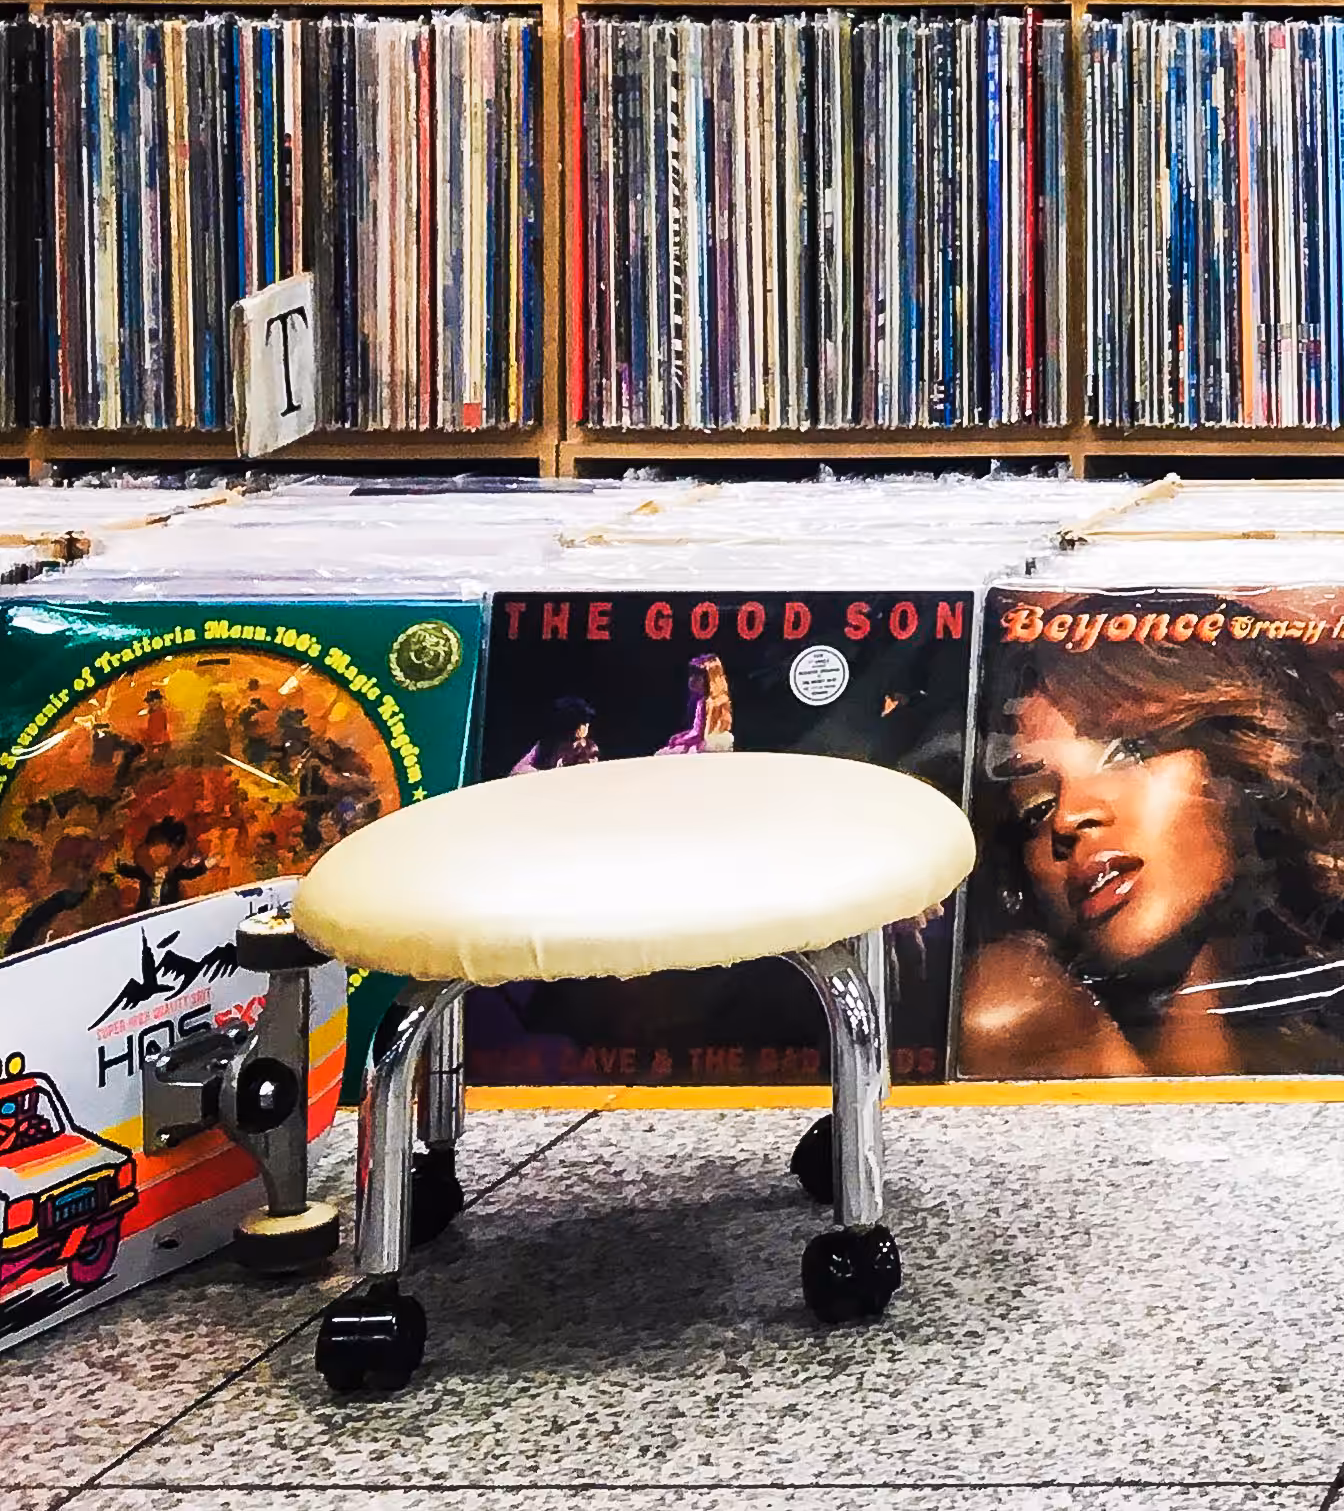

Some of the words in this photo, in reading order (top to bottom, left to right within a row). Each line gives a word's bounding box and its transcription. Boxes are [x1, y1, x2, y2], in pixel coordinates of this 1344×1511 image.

[264, 305, 309, 418] T
[504, 600, 613, 640] THE
[644, 601, 812, 640] GOOD
[844, 601, 965, 640] SON
[1001, 601, 1226, 651] Beyoncé
[1230, 614, 1330, 645] Crazy
[95, 625, 197, 674] Trattoria
[324, 647, 381, 700] Magic
[377, 694, 422, 784] Kingdom
